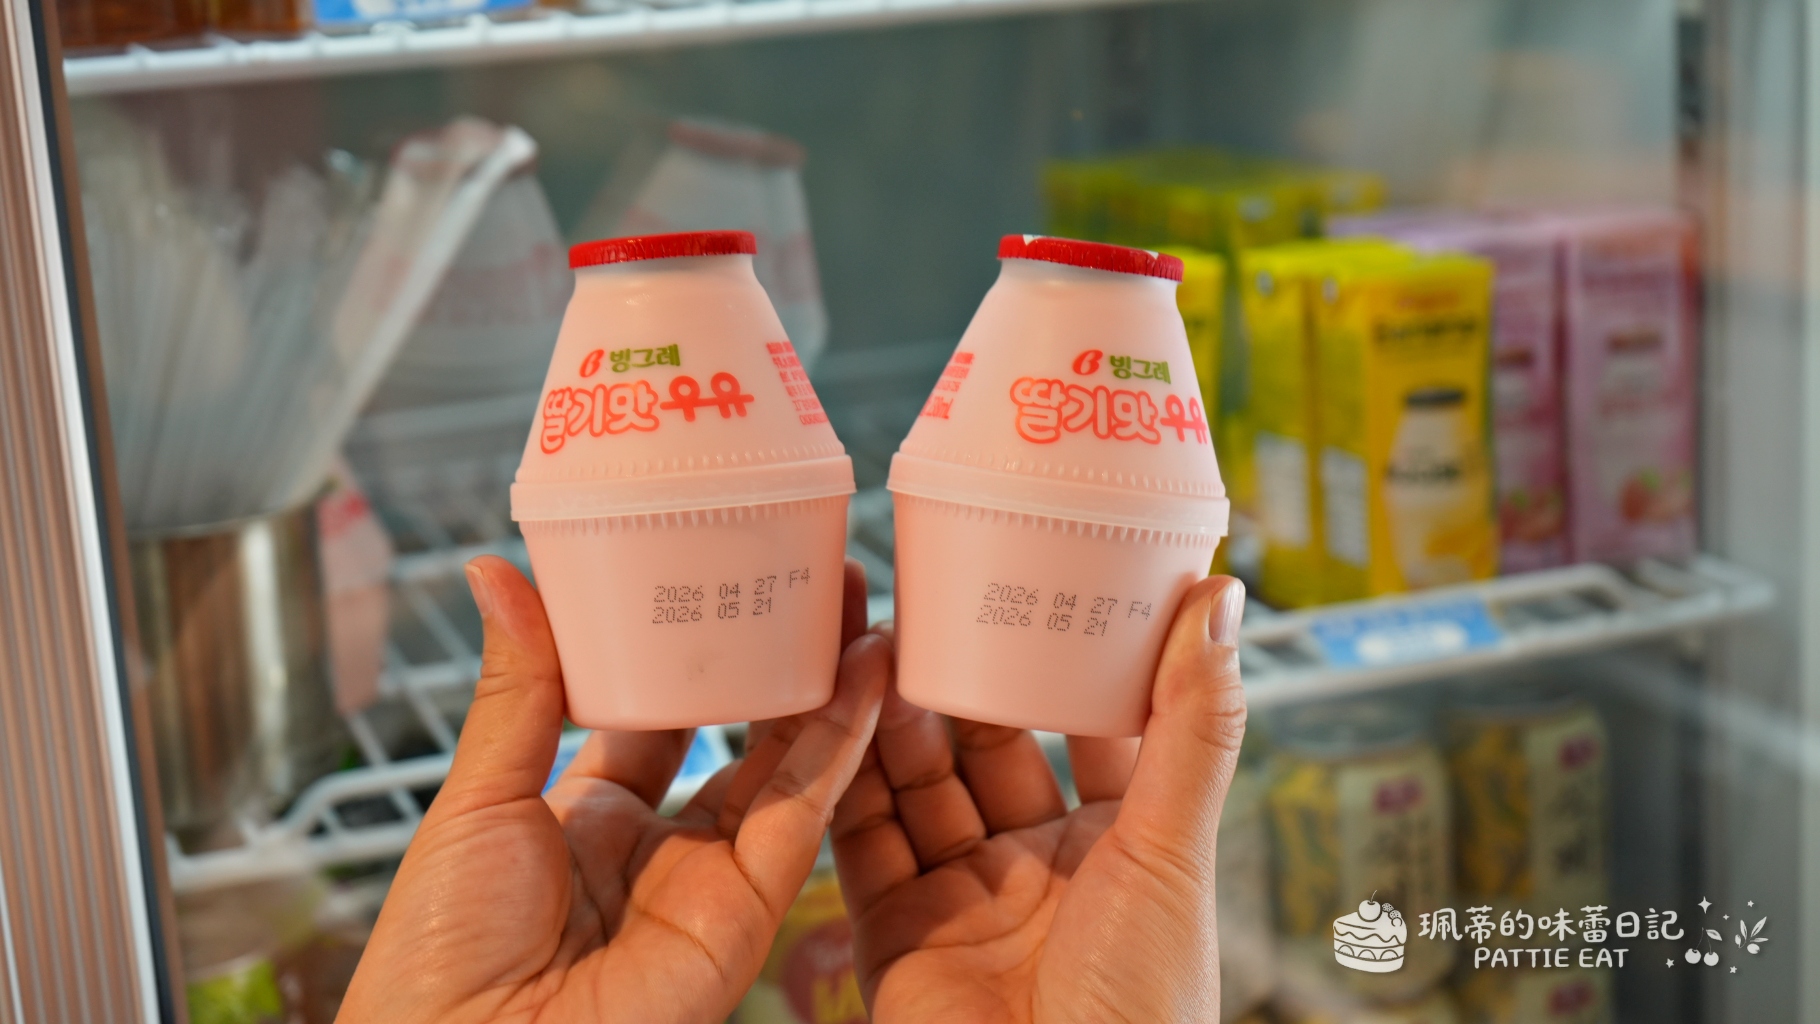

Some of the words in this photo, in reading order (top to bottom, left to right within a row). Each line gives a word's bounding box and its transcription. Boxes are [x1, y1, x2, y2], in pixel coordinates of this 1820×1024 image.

[609, 344, 681, 373] 빙그레
[1109, 355, 1171, 385] 빙그레
[653, 585, 704, 603] 2026
[719, 583, 741, 600] 04
[754, 575, 777, 595] 27
[789, 567, 811, 588] F4
[652, 605, 703, 624] 2026
[717, 601, 740, 619] 05
[752, 597, 772, 616] 21
[983, 582, 1039, 605] 2026
[1053, 592, 1077, 610] 04
[1090, 596, 1118, 615] 27
[1128, 601, 1152, 620] F4
[976, 604, 1032, 627] 2026
[1047, 612, 1073, 632] 05
[1083, 617, 1108, 637] 21
